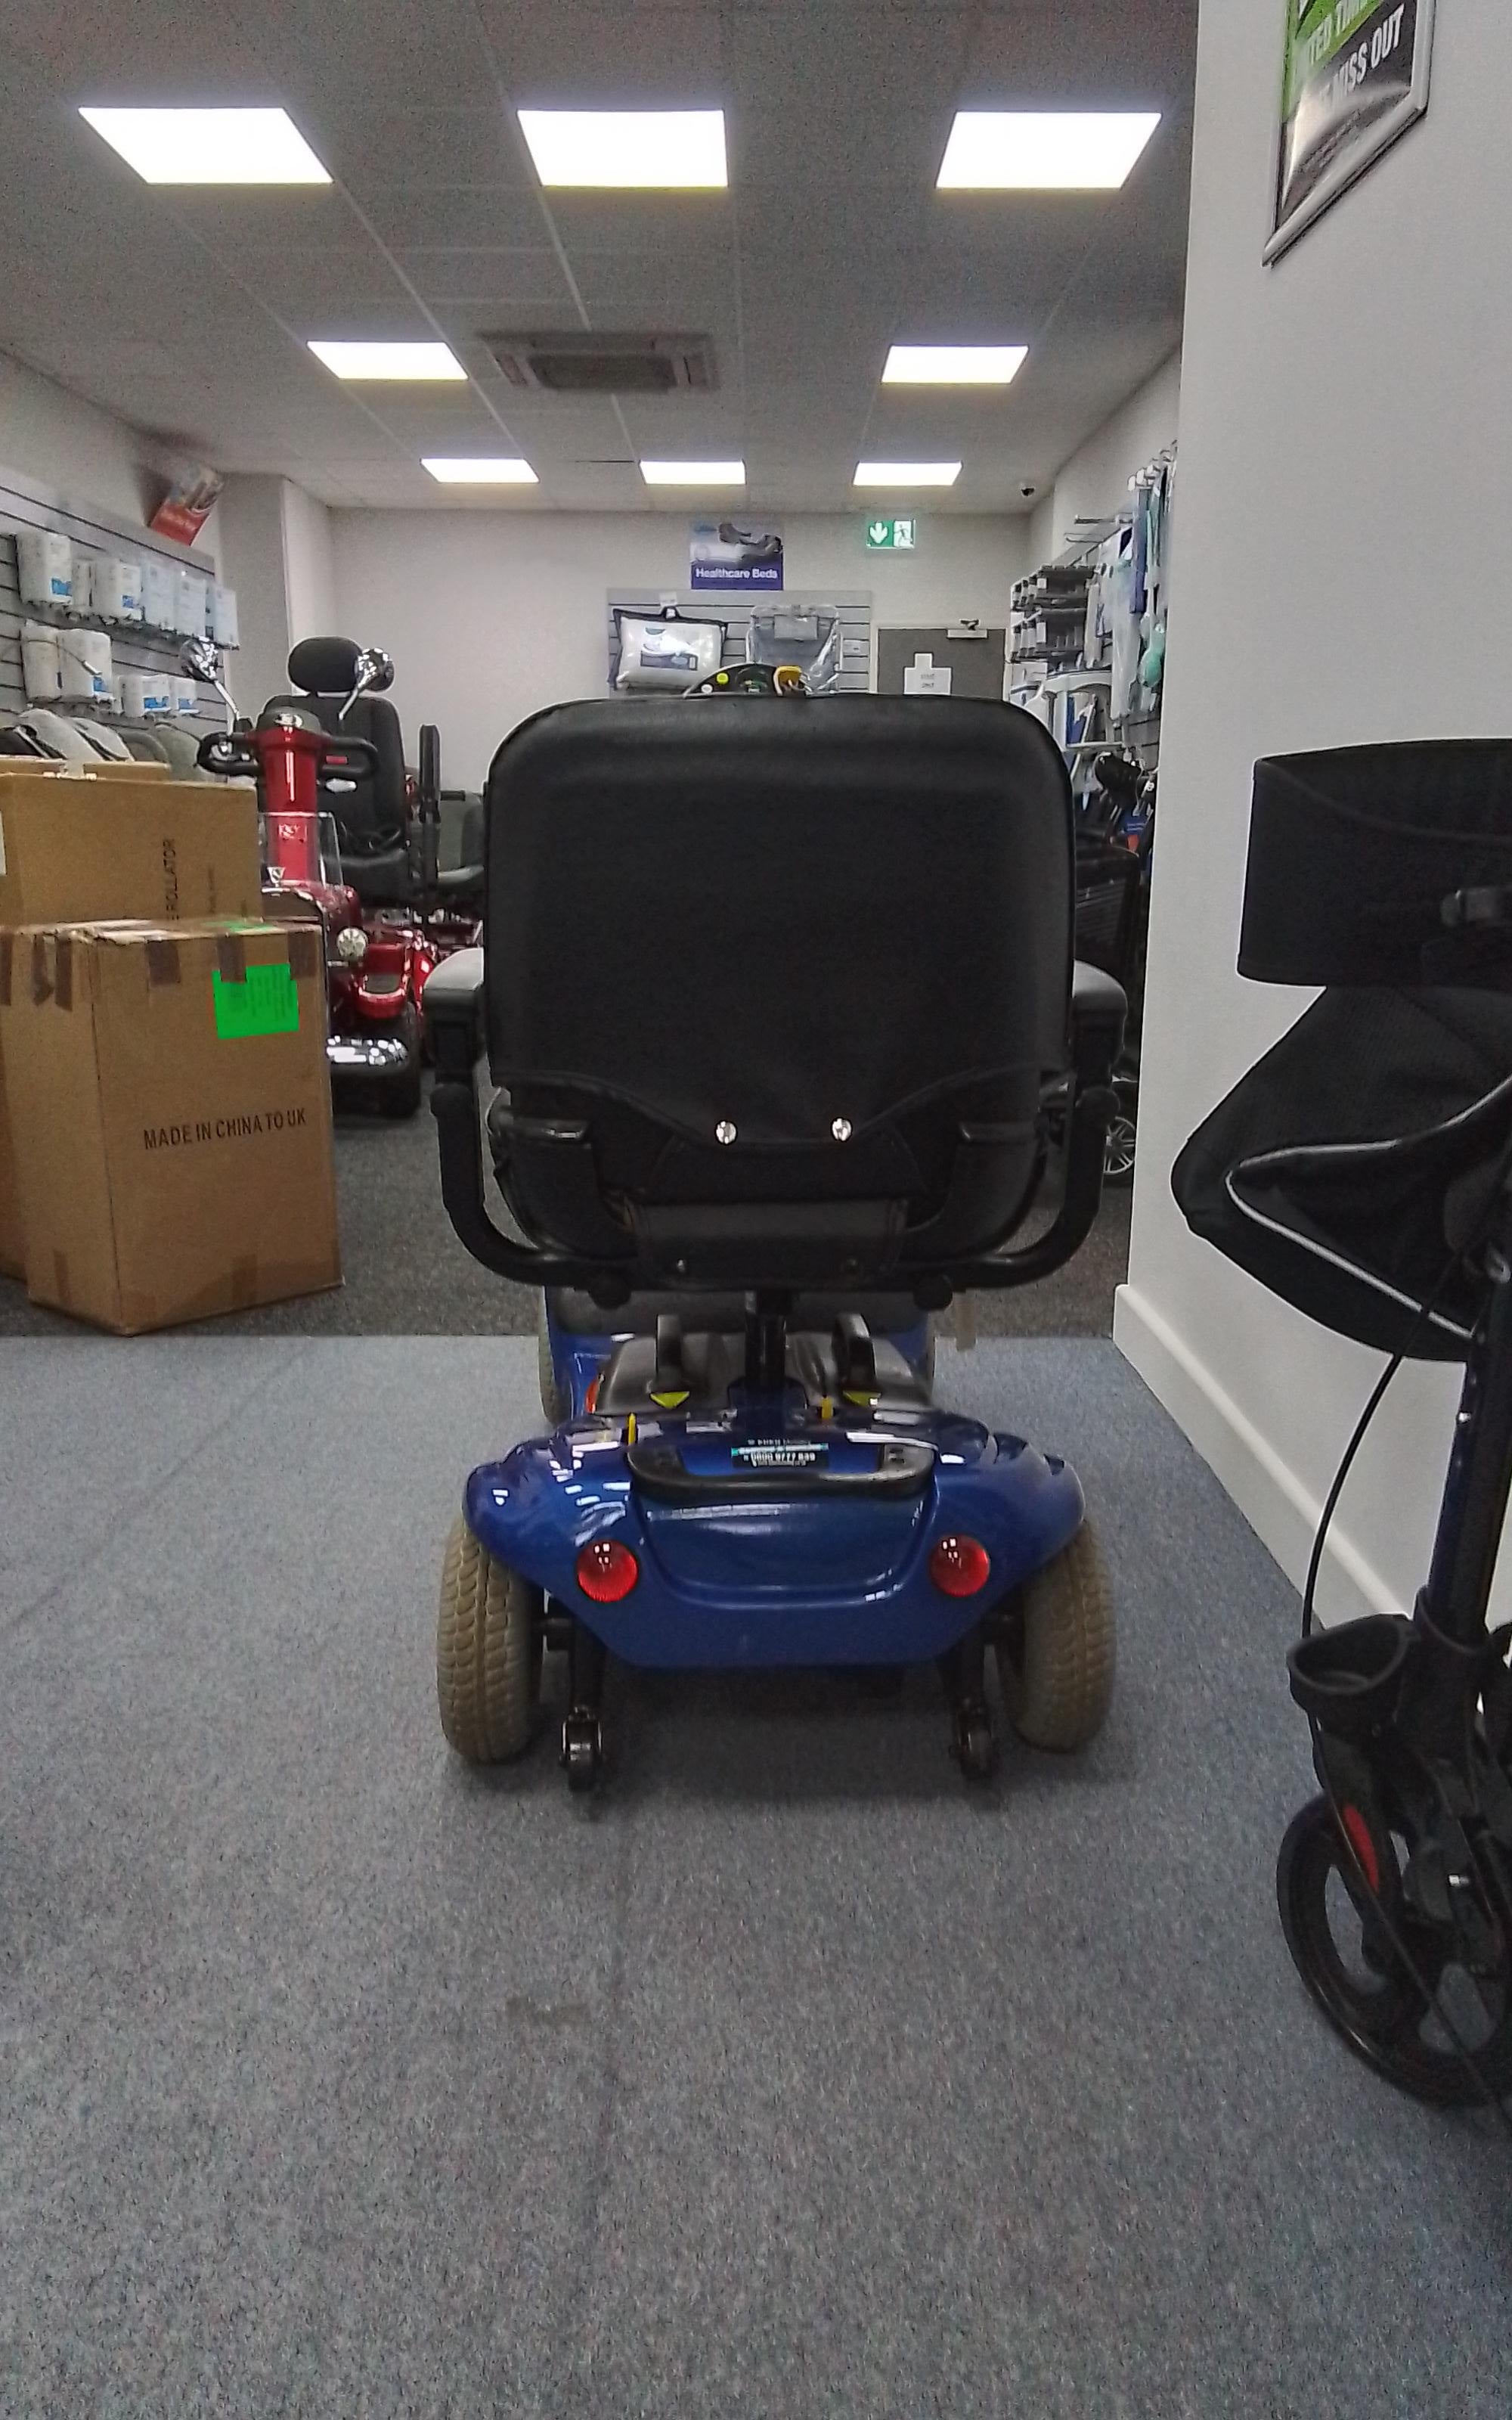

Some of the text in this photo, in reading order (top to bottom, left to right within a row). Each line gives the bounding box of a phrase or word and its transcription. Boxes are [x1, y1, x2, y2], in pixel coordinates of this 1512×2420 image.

[1332, 3, 1405, 108] MISS OUT
[696, 568, 778, 579] Healthcare Beds
[144, 1108, 306, 1150] MADE IN CHINA TO UK
